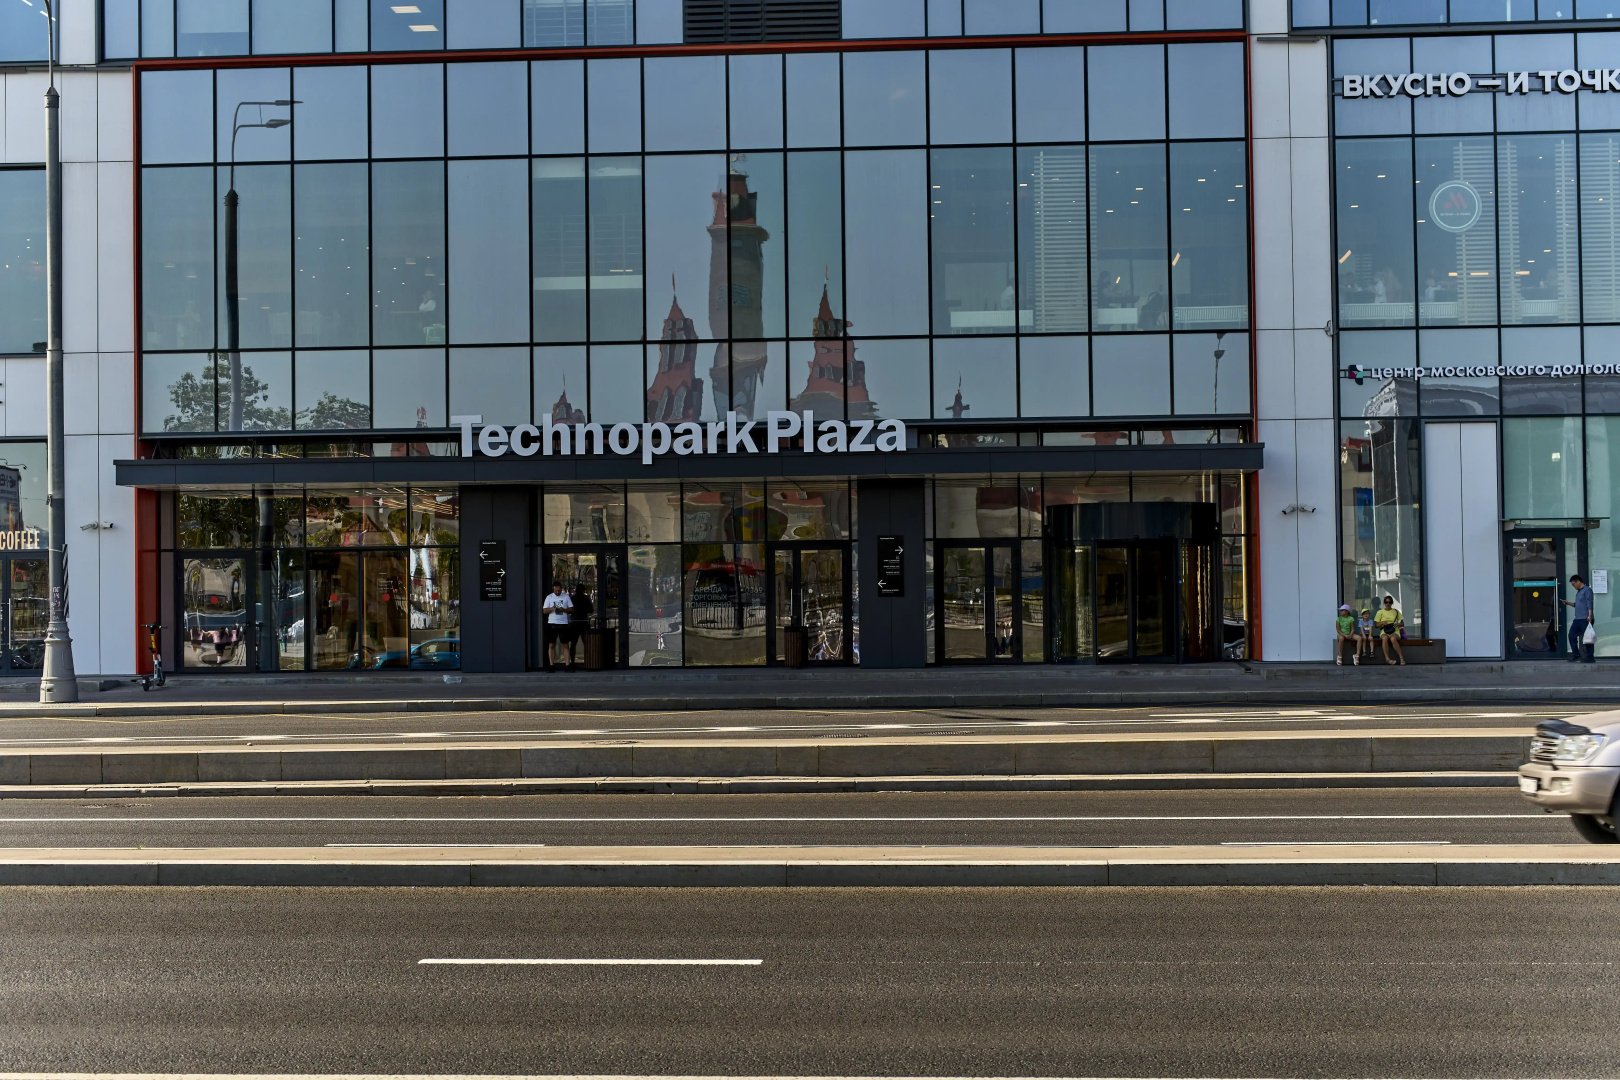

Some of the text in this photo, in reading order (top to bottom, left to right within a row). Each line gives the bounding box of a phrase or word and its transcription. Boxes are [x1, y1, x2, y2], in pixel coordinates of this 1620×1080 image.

[1343, 72, 1472, 97] ВКУСНО
[1371, 367, 1425, 381] центр
[1430, 365, 1546, 377] московского
[450, 410, 907, 465] Technopark Plaza
[0, 530, 40, 550] COFFEE
[685, 601, 732, 609] ПОМЕЩЕНИЙ
[689, 593, 728, 601] ТОРГОВЫХ
